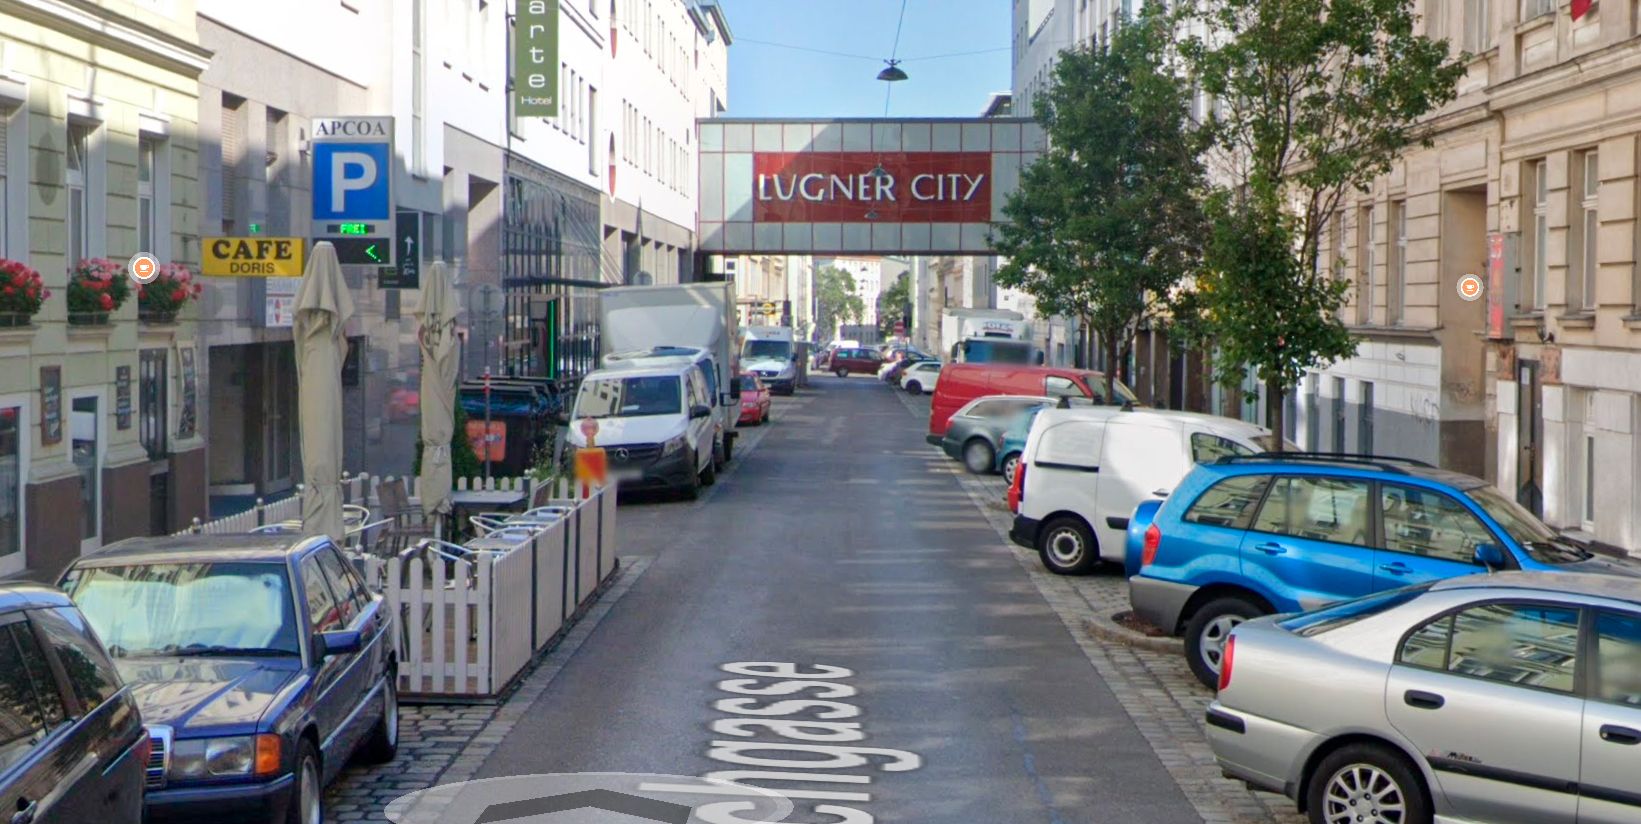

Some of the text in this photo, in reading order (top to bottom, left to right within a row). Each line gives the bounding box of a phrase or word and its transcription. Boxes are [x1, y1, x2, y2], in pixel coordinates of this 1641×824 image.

[528, 0, 546, 89] arte
[520, 95, 553, 105] Hotel
[316, 119, 386, 136] APCOA
[331, 152, 378, 213] P
[757, 173, 985, 202] LUGNER CITY
[212, 239, 293, 261] CAFE
[230, 262, 275, 274] DORIS
